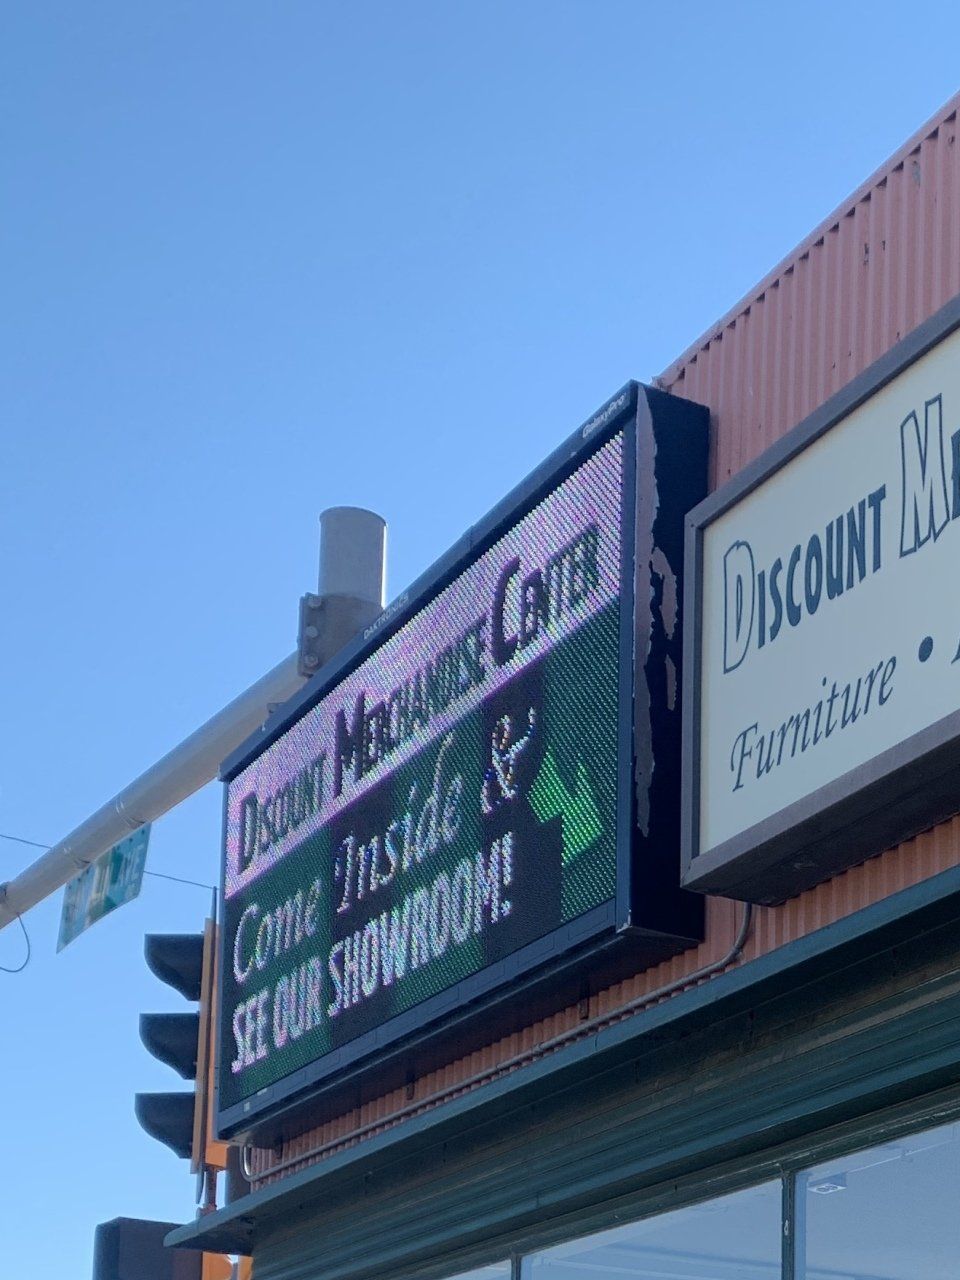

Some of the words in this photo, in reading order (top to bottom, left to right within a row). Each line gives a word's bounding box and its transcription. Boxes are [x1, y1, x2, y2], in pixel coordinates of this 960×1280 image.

[723, 483, 886, 674] DISCOUNT
[731, 656, 897, 792] Furniture
[231, 992, 269, 1075] SEE
[272, 956, 325, 1047] OUR
[328, 830, 515, 1018] SHOWROOM!
[234, 880, 323, 985] Come
[335, 728, 464, 914] Inside
[481, 705, 537, 815] &
